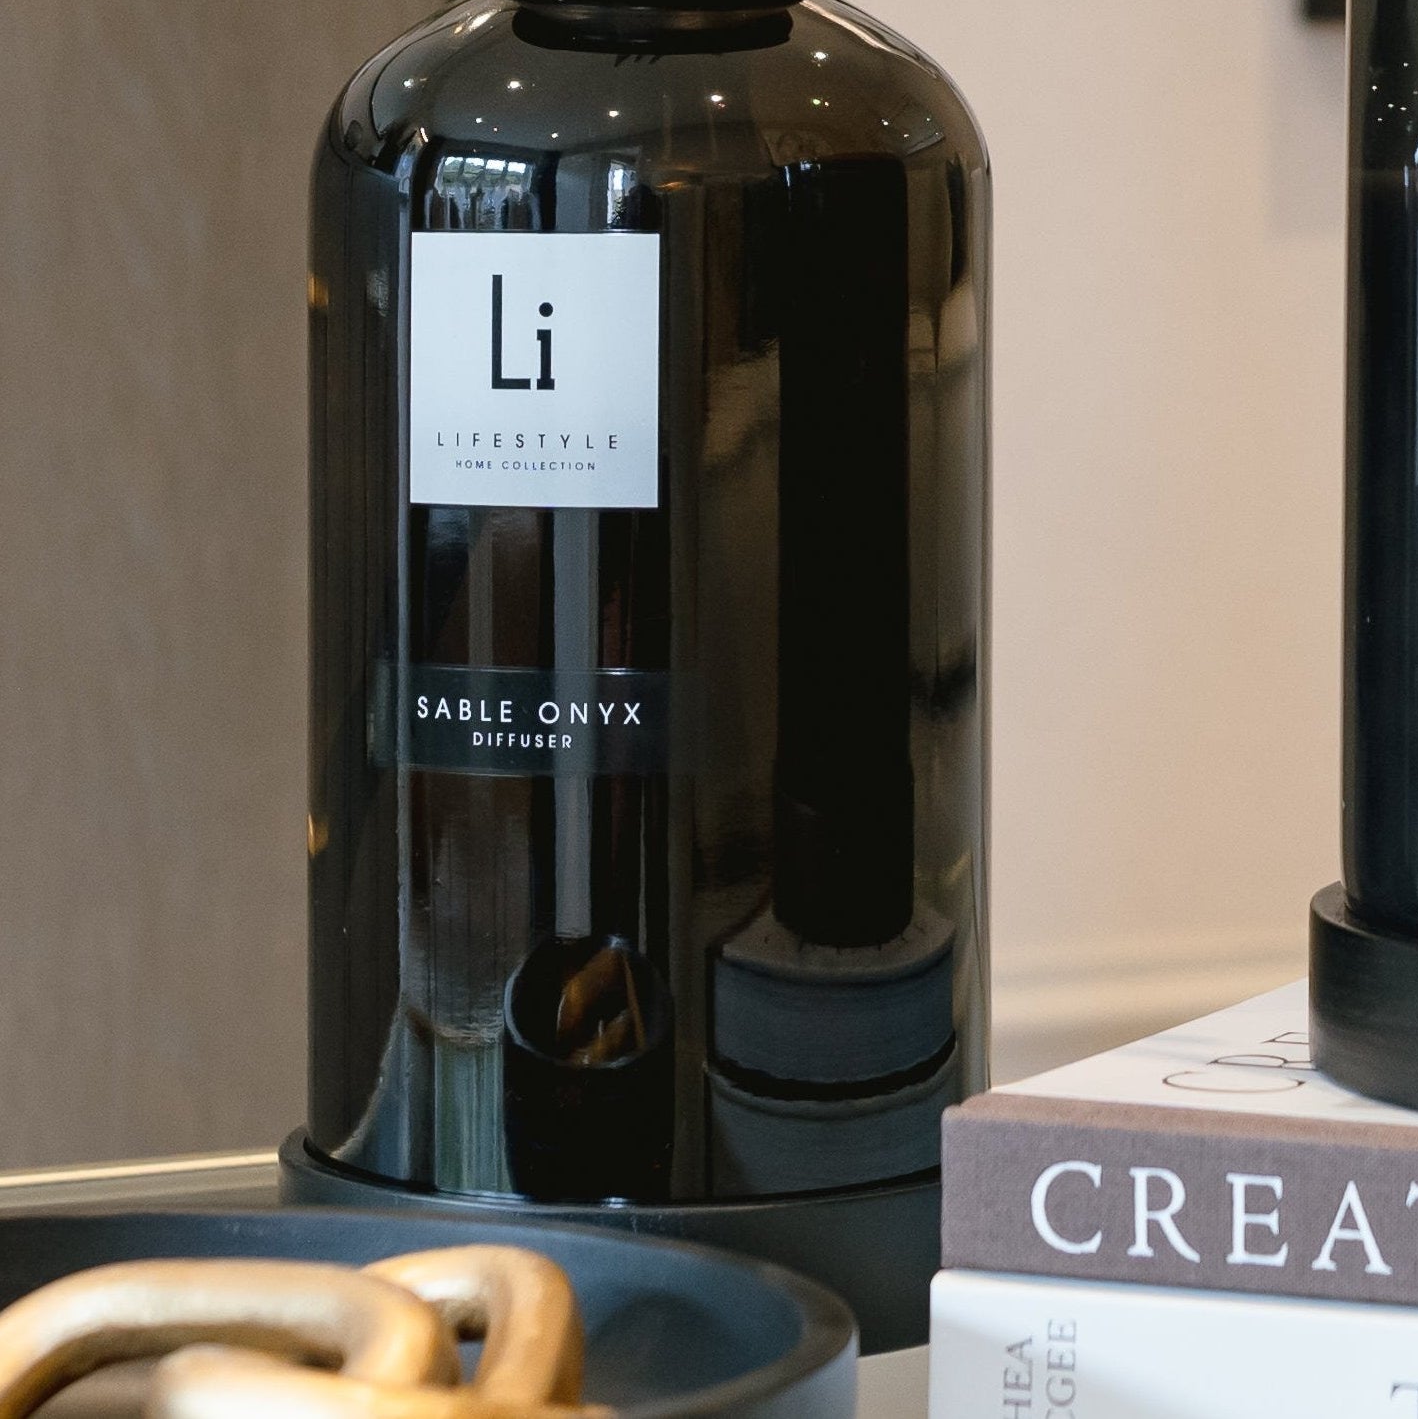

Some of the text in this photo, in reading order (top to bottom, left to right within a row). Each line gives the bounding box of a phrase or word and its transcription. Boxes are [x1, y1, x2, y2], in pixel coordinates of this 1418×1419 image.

[490, 274, 556, 391] Li
[437, 431, 618, 450] LIFESTYLE
[455, 459, 596, 471] HOME COLLECTION
[417, 695, 642, 726] SABLE ONYX
[472, 731, 573, 749] DIFFUSER
